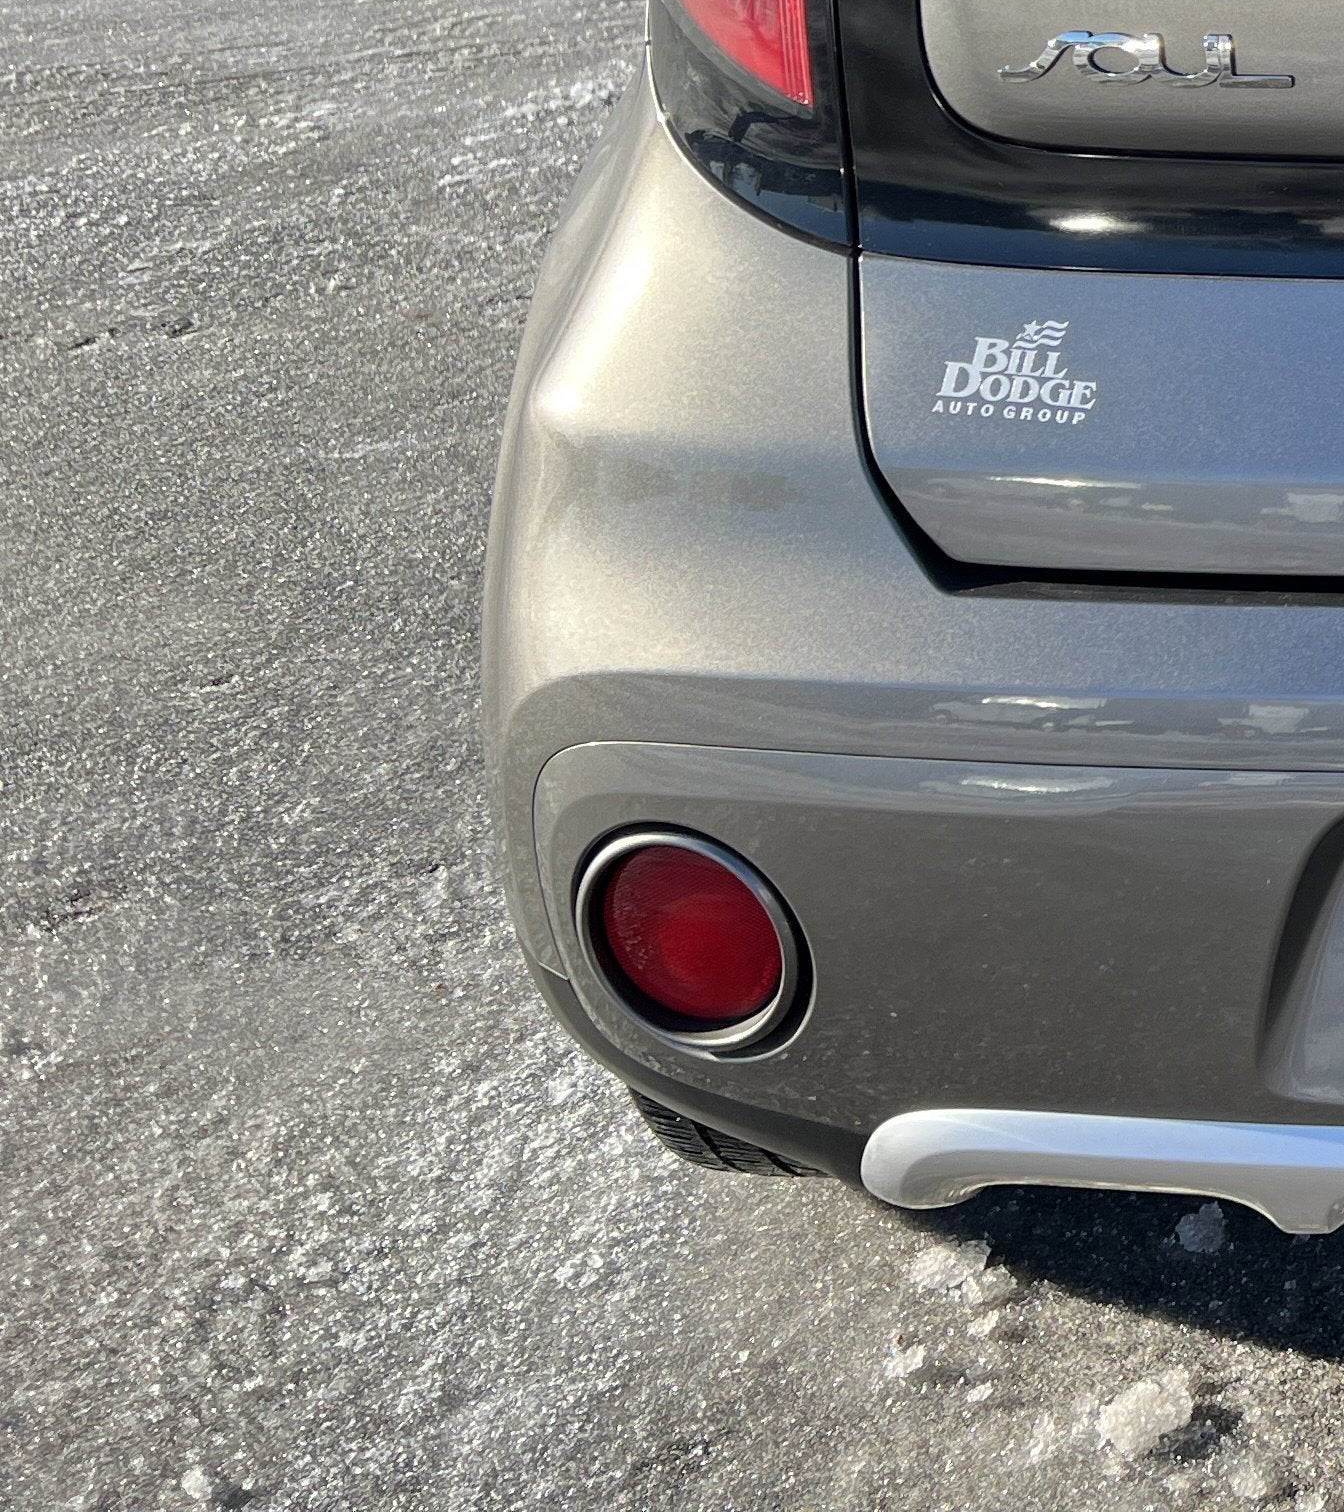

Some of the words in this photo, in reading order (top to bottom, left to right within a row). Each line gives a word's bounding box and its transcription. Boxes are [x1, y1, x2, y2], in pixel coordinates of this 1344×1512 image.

[971, 335, 1068, 379] BILL
[935, 360, 1098, 410] DODGE
[931, 399, 994, 418] AUTO
[1002, 405, 1087, 425] GROUP
